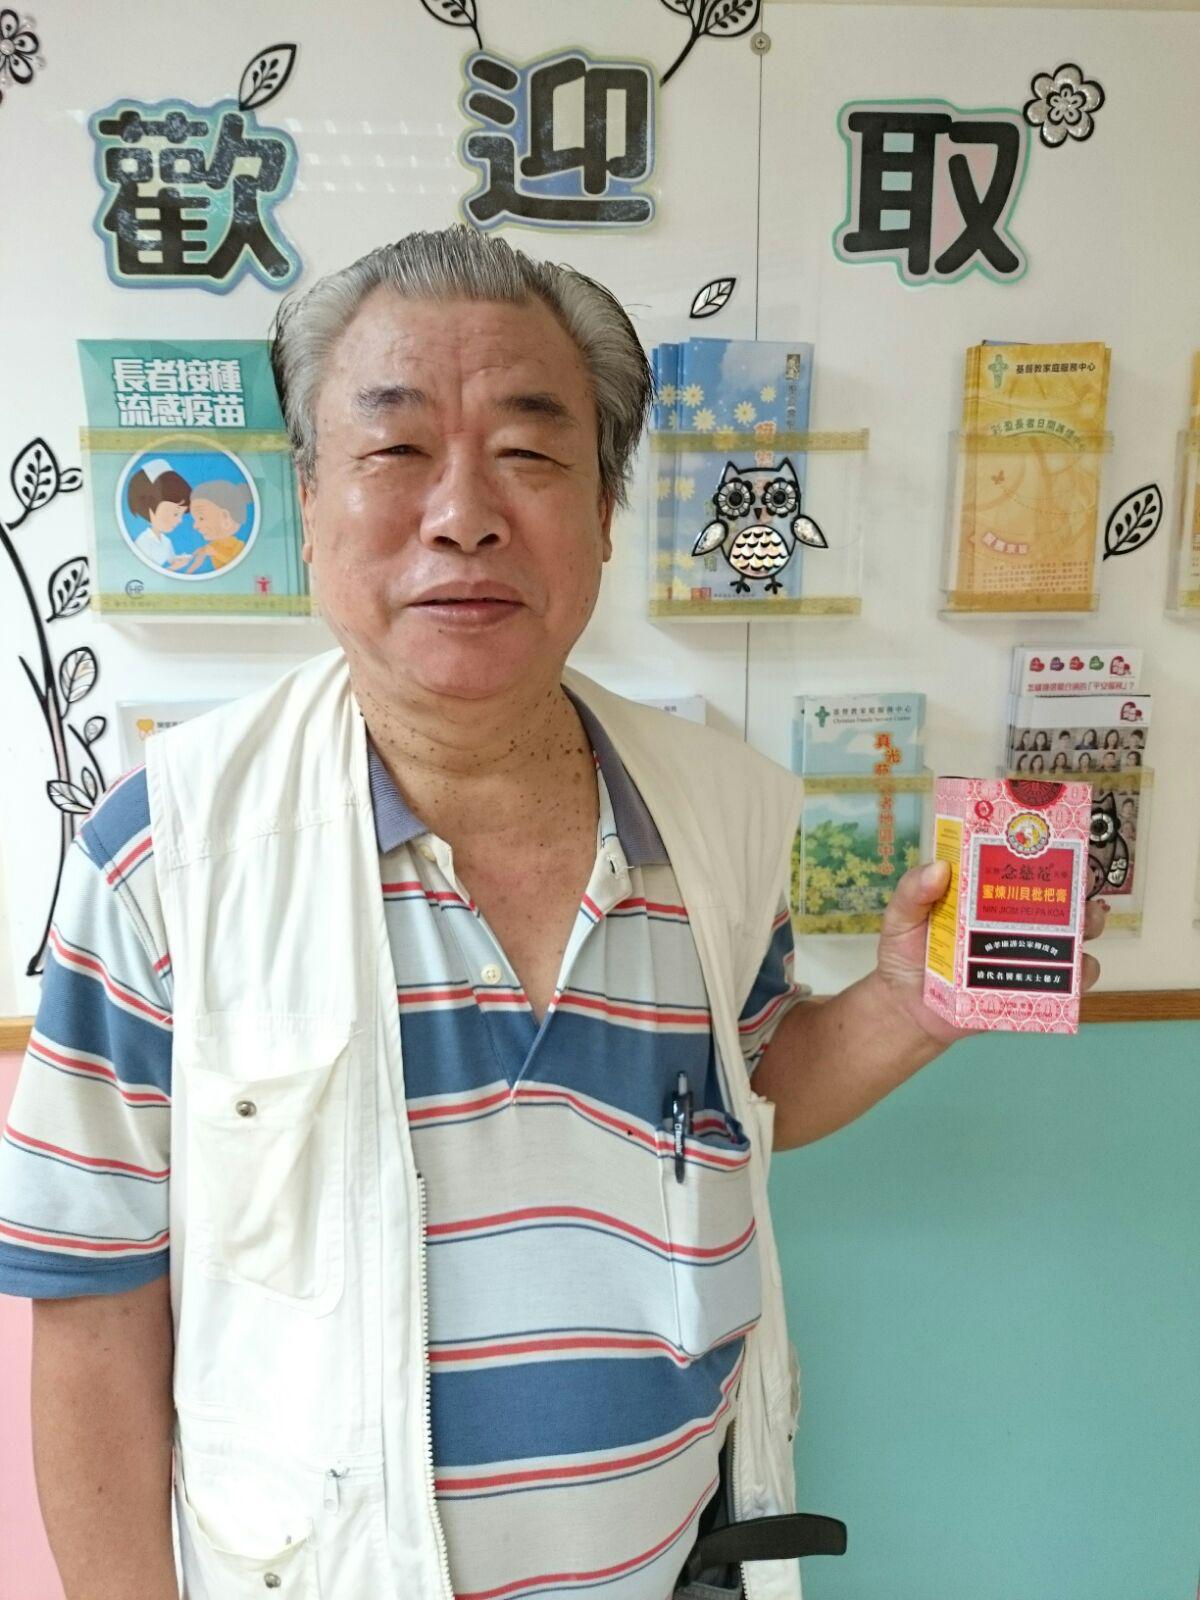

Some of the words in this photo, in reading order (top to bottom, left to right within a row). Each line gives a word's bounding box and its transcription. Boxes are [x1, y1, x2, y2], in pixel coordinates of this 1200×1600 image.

[96, 108, 293, 281] 歡
[466, 57, 655, 223] 迎
[842, 110, 1022, 276] 取
[112, 358, 243, 393] 長者接種
[1016, 363, 1096, 374] 基督教家庭服務中心
[115, 393, 246, 427] 流感疫苗
[982, 885, 1068, 903] 蜜煉川貝枇杷膏
[982, 905, 997, 913] NIN
